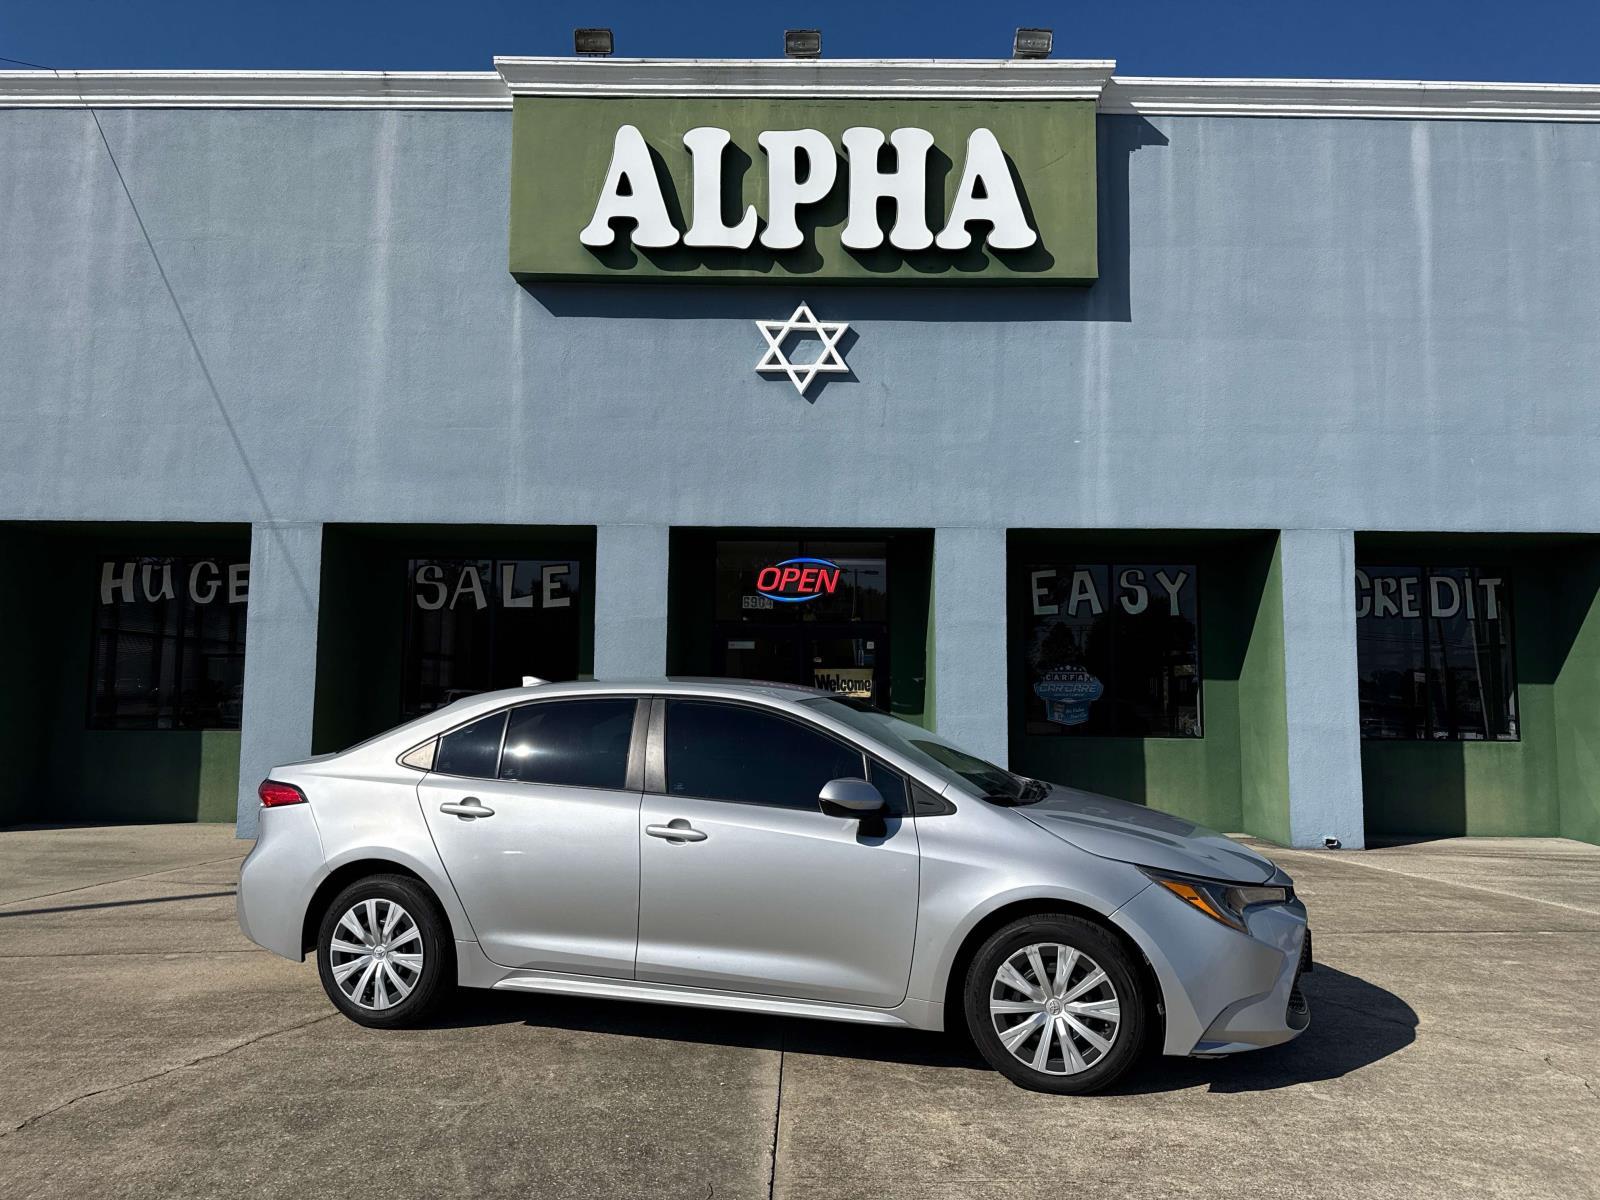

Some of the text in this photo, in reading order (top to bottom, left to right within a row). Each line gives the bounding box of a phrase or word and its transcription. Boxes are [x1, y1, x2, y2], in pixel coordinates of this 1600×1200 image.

[579, 124, 1037, 250] ALPHA
[100, 561, 250, 605] HUGE
[415, 564, 571, 611] SALE
[757, 567, 840, 593] OPEN
[1031, 568, 1190, 616] EASY
[815, 674, 872, 693] Welcome
